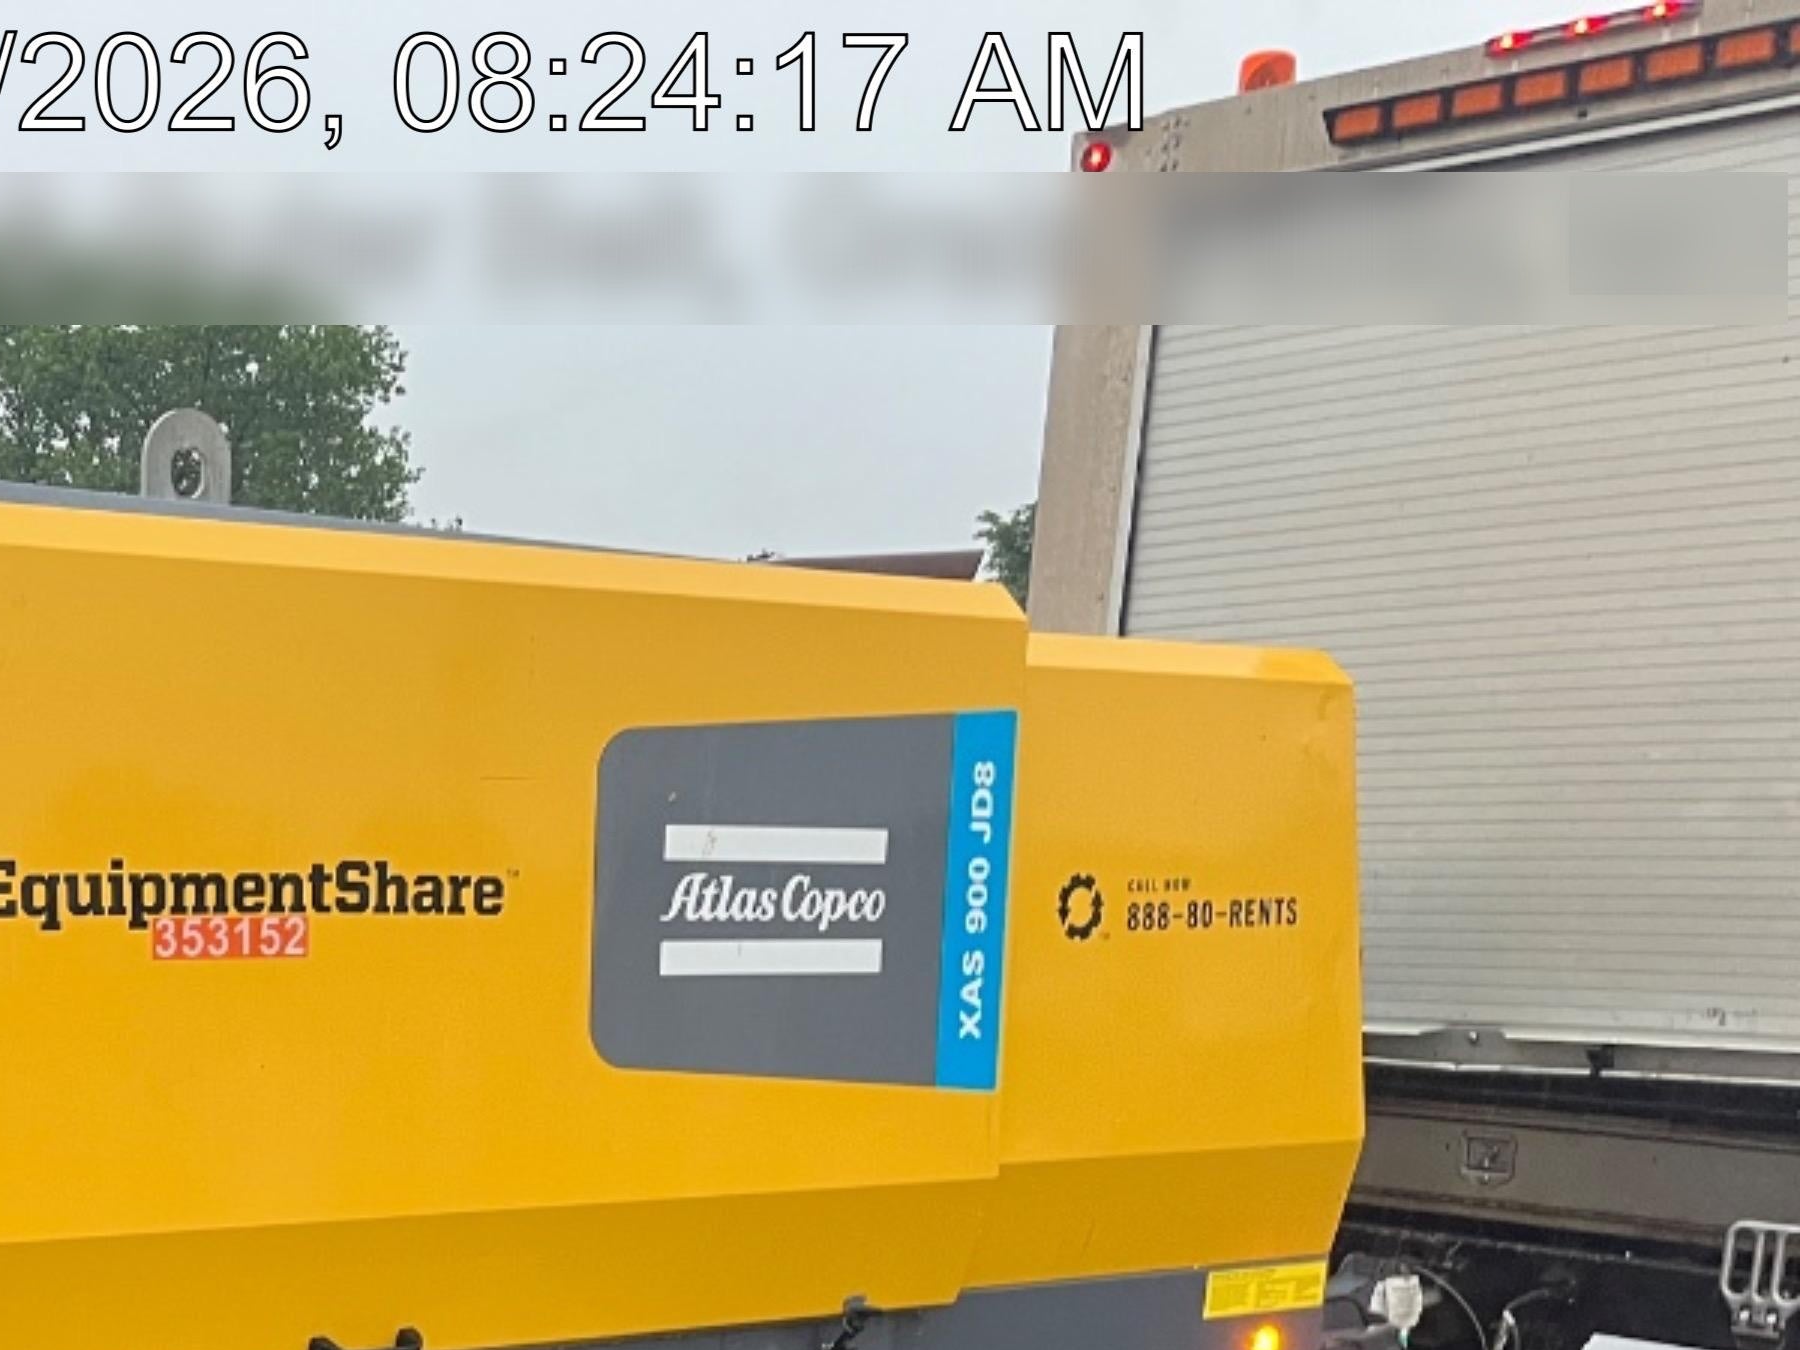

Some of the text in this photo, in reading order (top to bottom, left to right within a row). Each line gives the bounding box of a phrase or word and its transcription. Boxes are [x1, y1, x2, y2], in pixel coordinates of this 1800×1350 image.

[660, 872, 886, 932] Atlas Copco
[959, 760, 997, 1039] XAS 900 JD8
[1126, 897, 1298, 931] 888-80-RENTS
[154, 916, 306, 957] 353152
